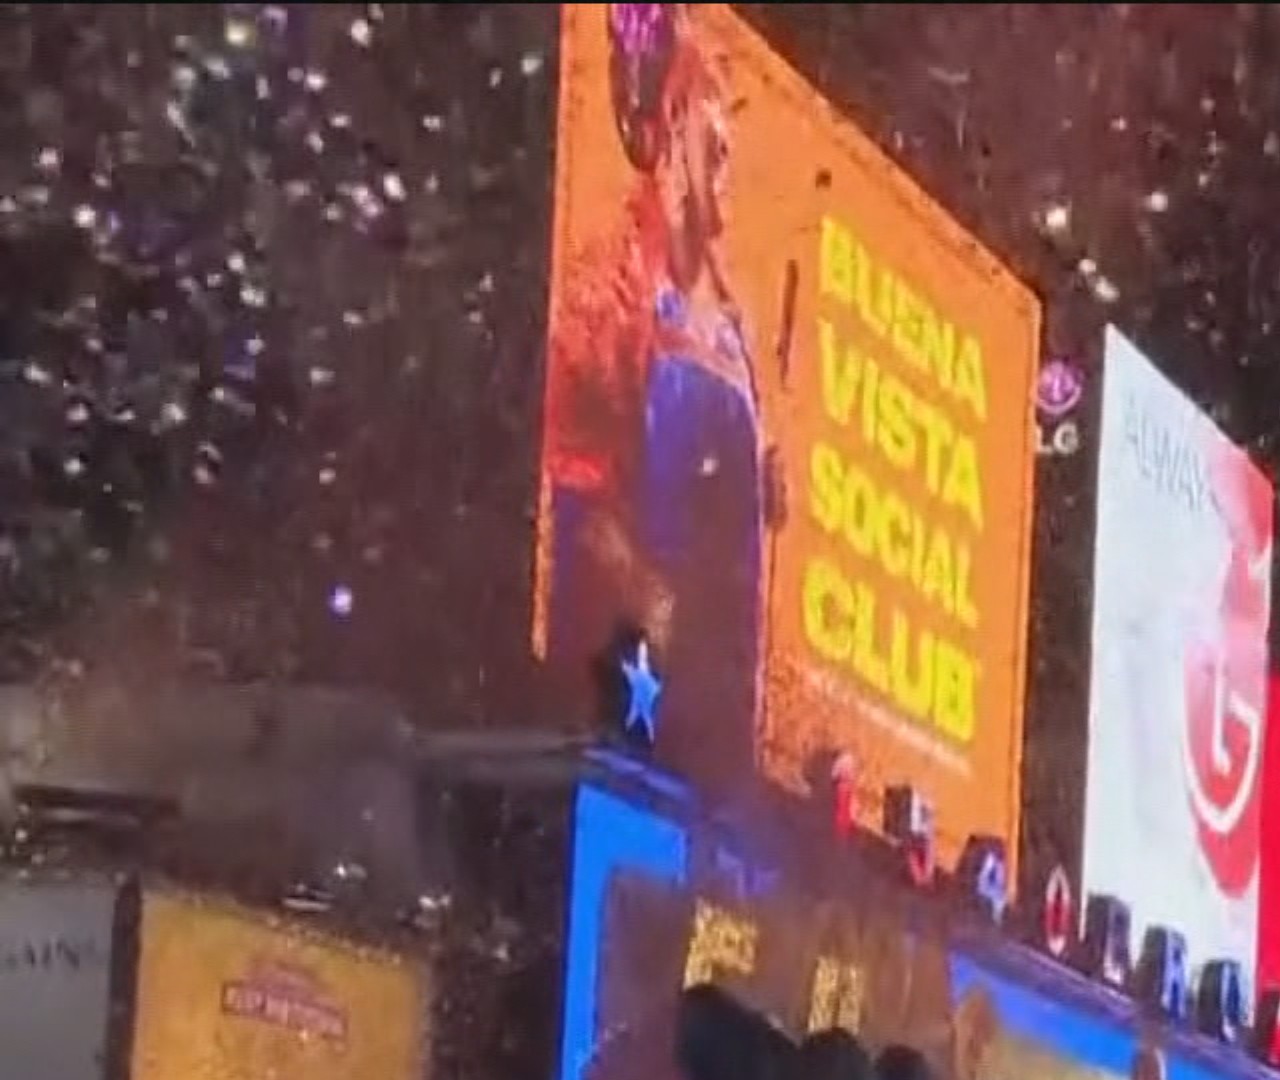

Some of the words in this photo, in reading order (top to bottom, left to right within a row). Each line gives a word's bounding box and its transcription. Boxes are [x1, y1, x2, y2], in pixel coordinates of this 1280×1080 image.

[821, 213, 987, 421] BUENA
[817, 316, 984, 532] VISTA
[1036, 423, 1080, 455] LG
[809, 440, 980, 630] SOCIAL
[803, 558, 977, 743] CLUB
